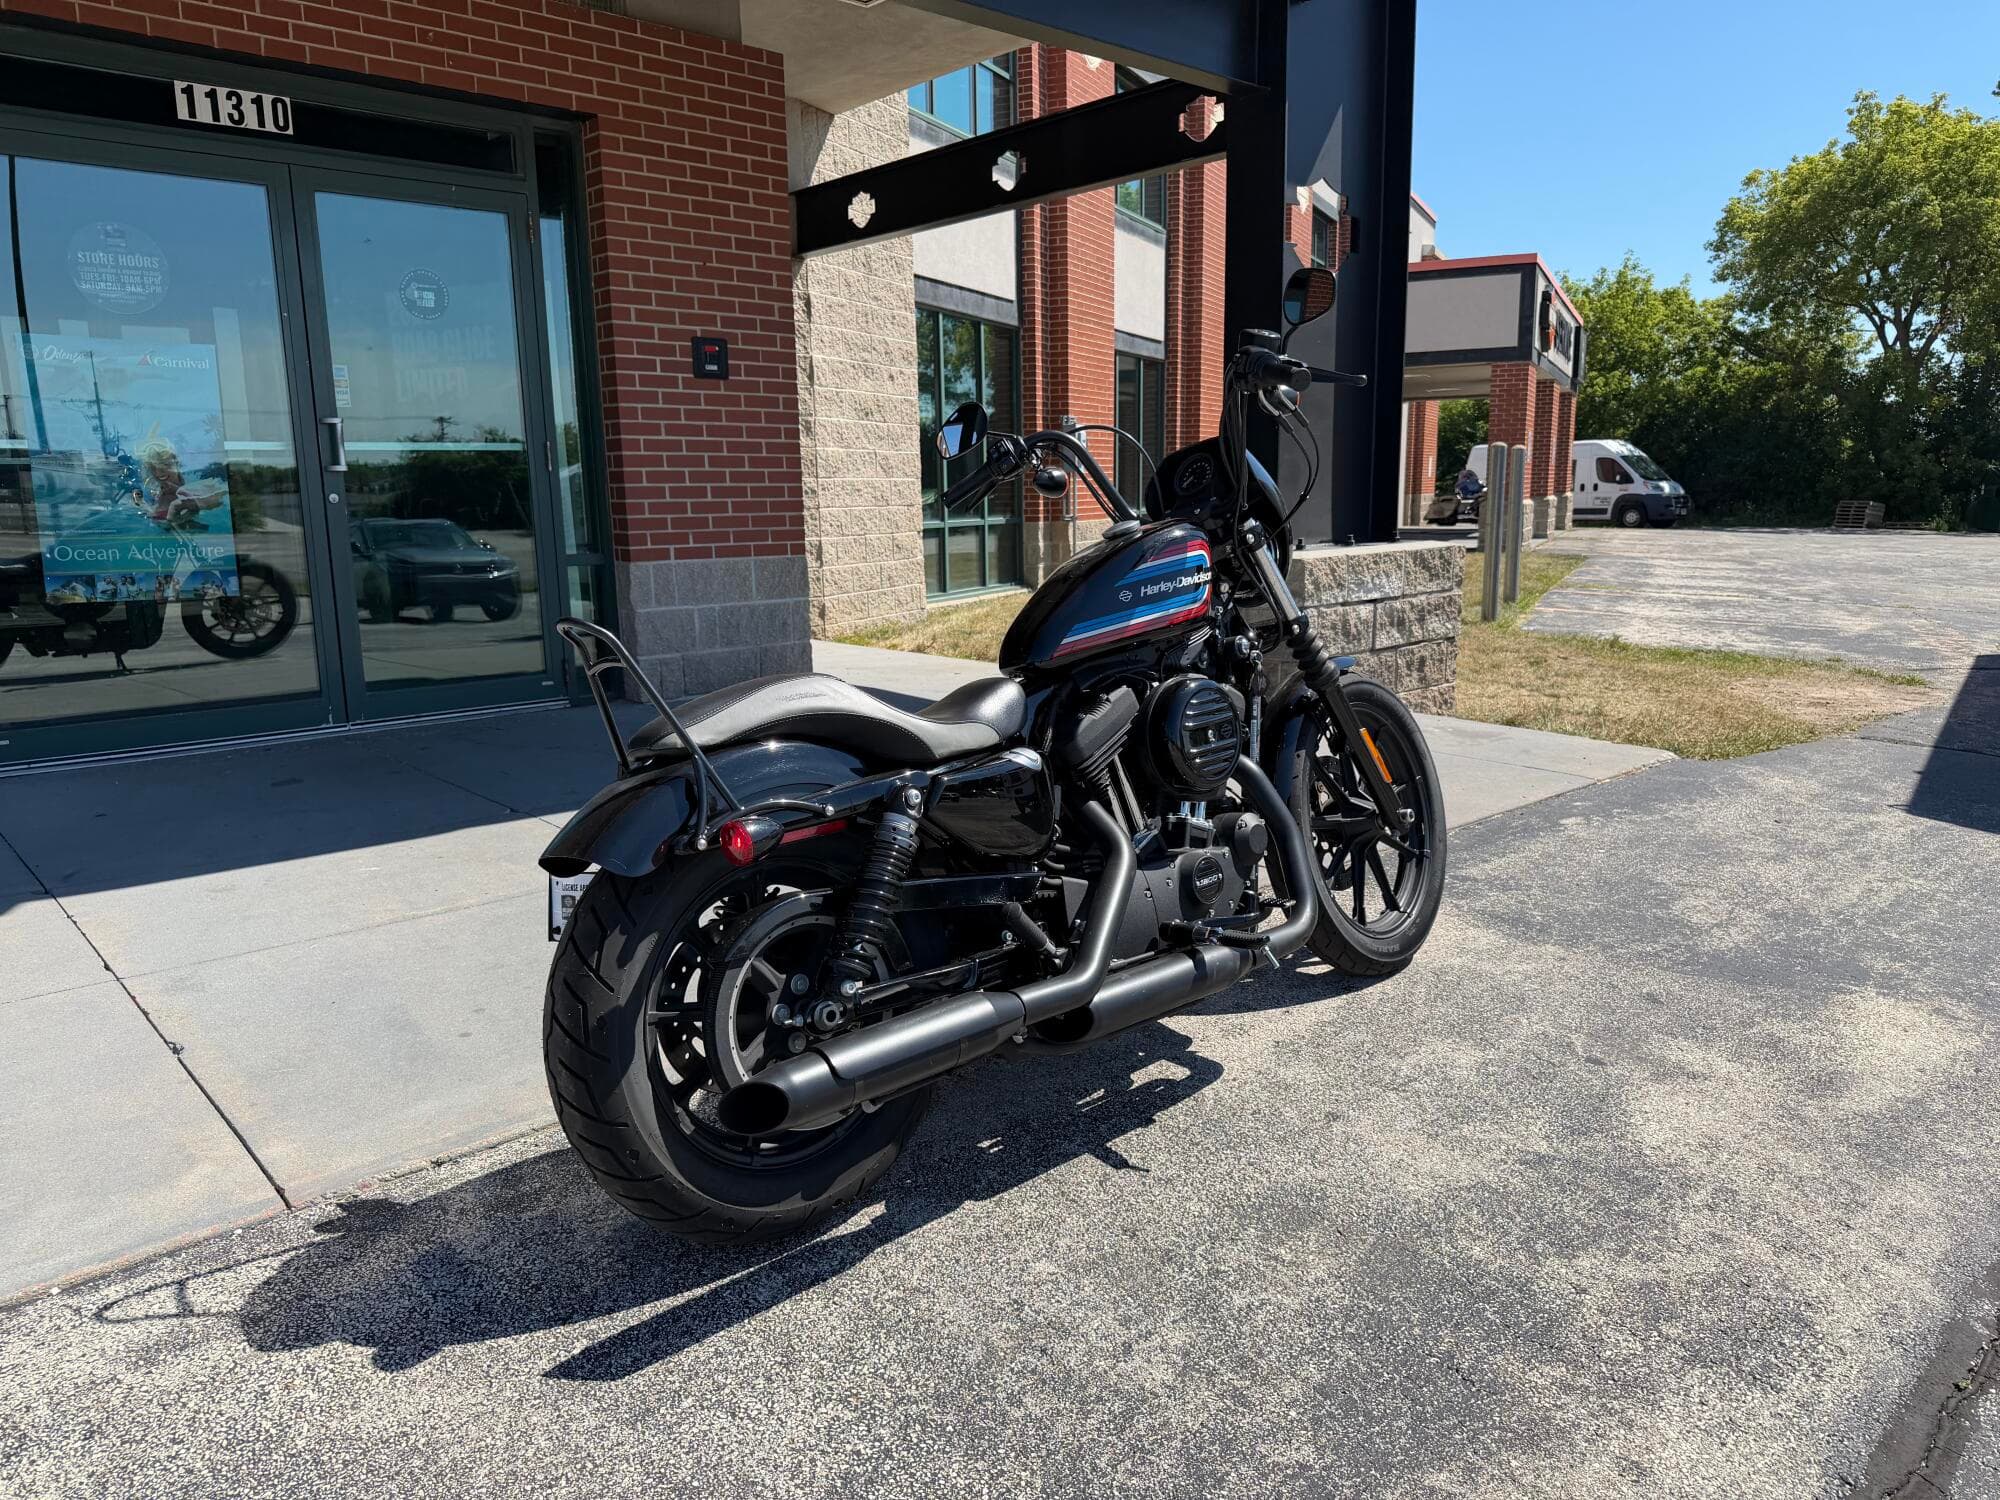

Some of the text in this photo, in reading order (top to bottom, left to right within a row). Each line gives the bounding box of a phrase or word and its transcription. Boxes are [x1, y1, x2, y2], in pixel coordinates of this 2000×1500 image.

[181, 84, 290, 132] 11310
[78, 250, 159, 268] STORE HOURS
[155, 356, 209, 369] Carnival
[54, 543, 224, 562] Ocean Adventure
